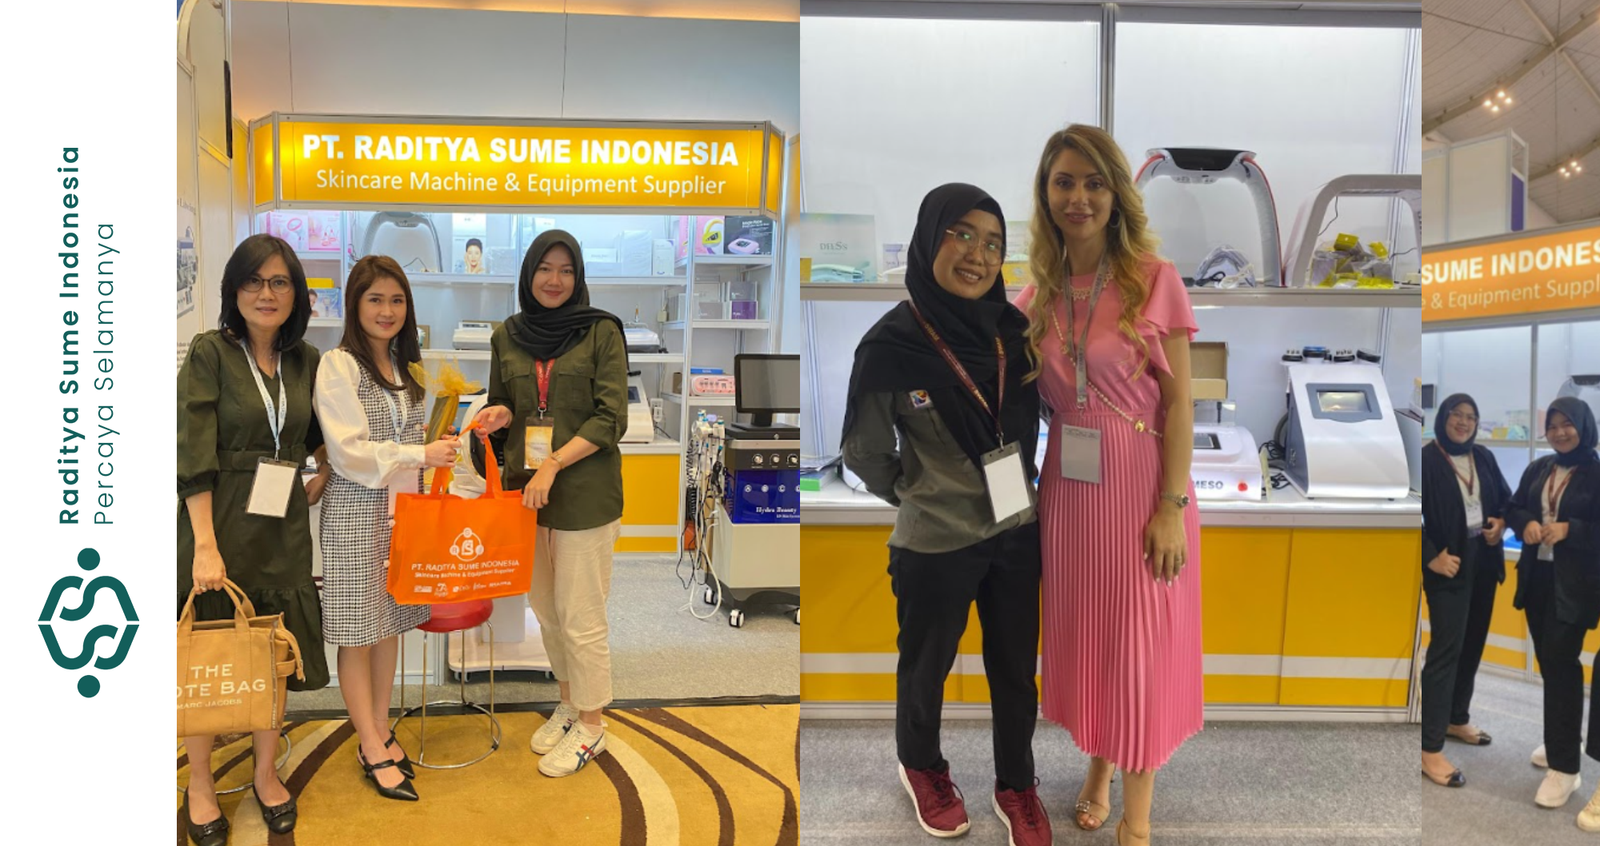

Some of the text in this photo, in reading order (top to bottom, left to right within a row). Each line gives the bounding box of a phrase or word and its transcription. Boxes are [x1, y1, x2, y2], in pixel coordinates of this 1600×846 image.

[303, 134, 739, 166] PT. RADITYA SUME INDONESIA
[316, 169, 726, 198] Skincare Machine & Equipment Supplier
[1422, 256, 1484, 286] SUME
[1430, 292, 1443, 310] &
[1448, 284, 1541, 310] Equipment
[190, 664, 233, 679] THE
[220, 678, 266, 695] BAG
[205, 699, 242, 707] JACOBS
